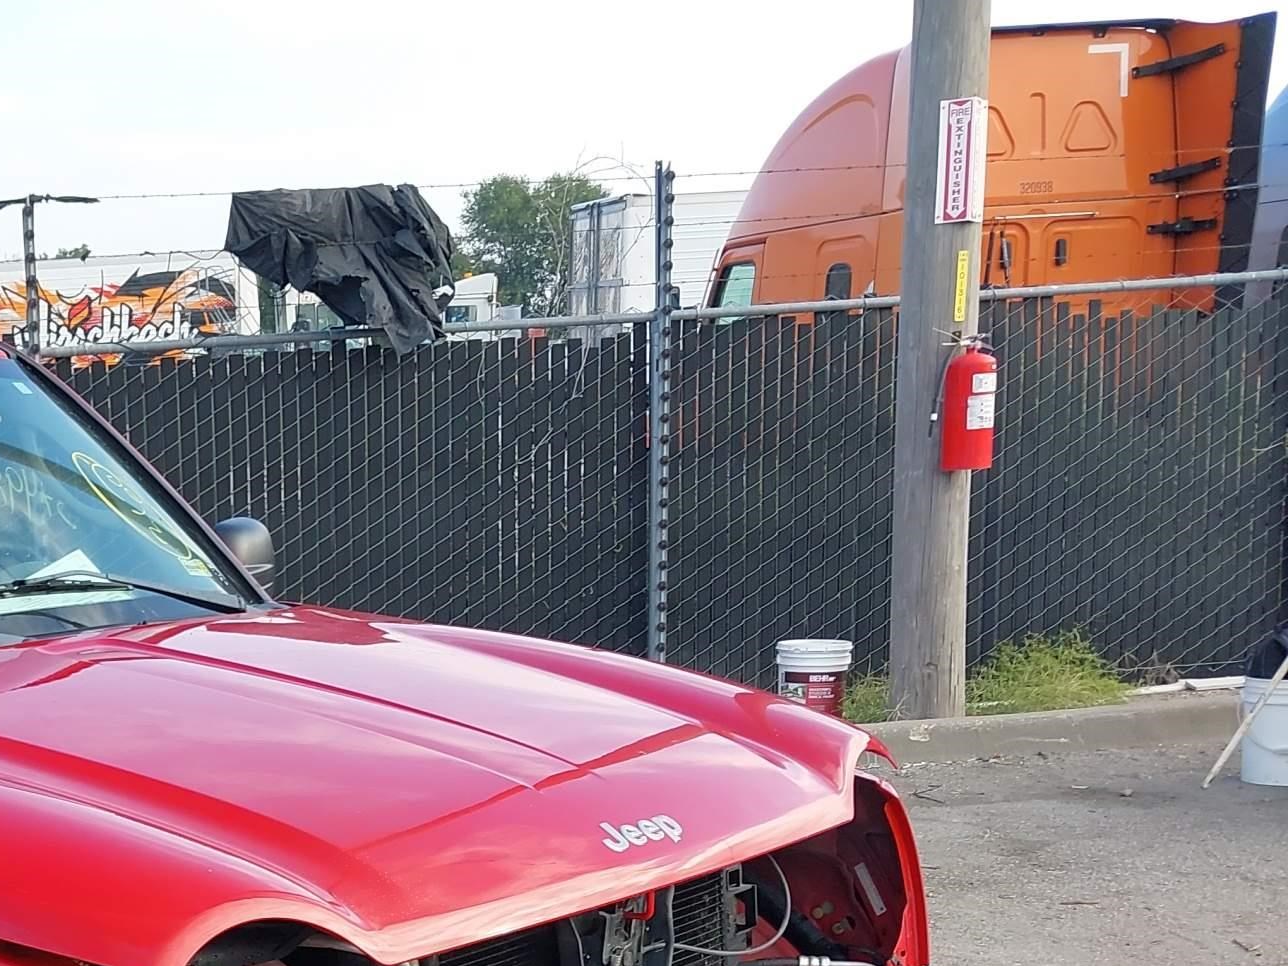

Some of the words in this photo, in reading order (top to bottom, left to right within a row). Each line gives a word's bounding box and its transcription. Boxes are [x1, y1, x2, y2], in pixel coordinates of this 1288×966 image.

[950, 106, 970, 117] FIRE
[950, 117, 964, 212] EXTINGUISHER
[599, 814, 683, 853] Jeep
